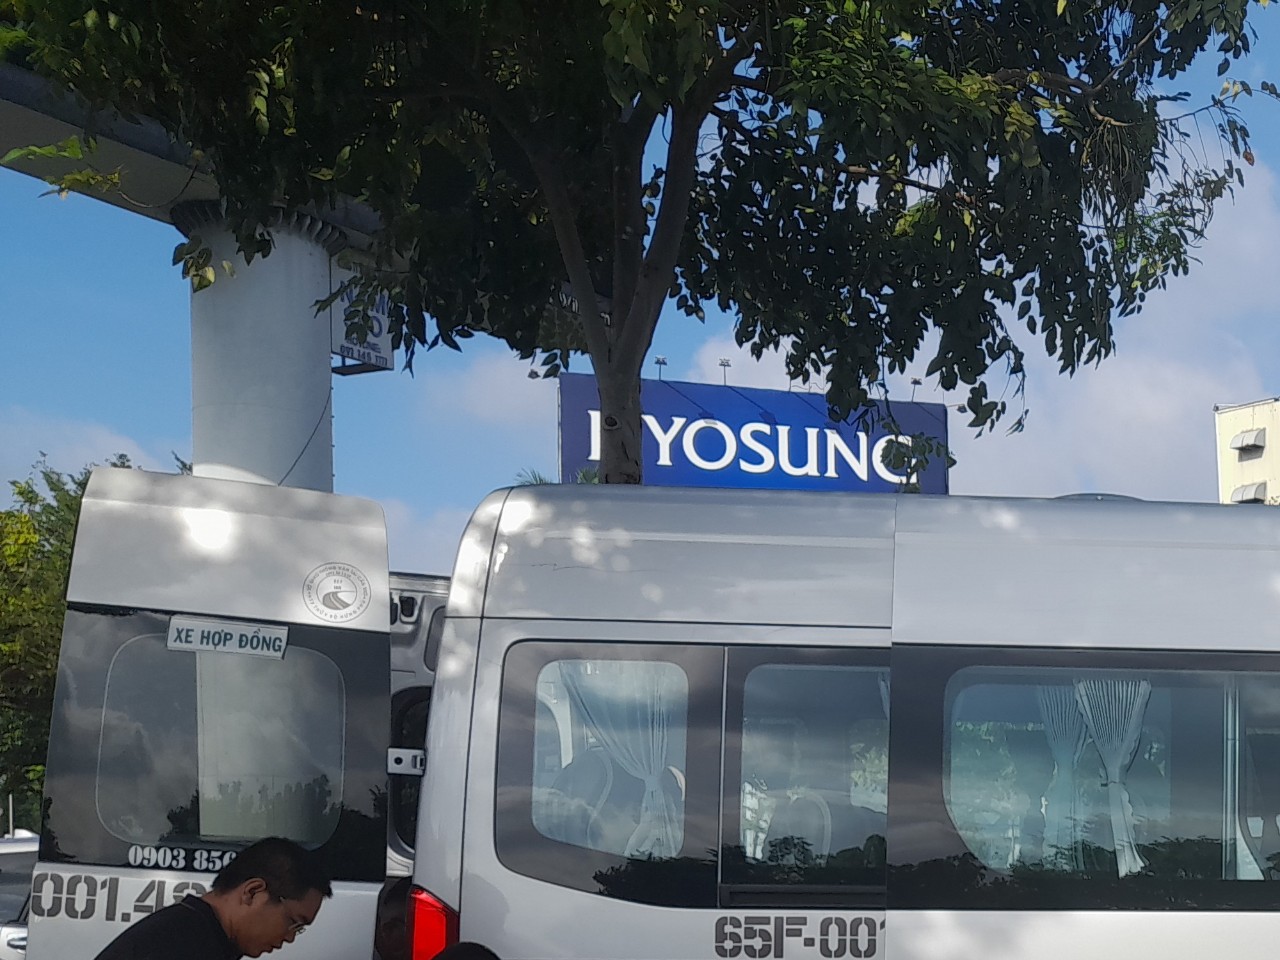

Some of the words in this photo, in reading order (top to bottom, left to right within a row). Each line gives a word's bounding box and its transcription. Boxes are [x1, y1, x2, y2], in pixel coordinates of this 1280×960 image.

[174, 627, 194, 644] XE
[200, 629, 233, 650] HỢP
[238, 628, 283, 652] ĐỒNG
[128, 844, 186, 870] 0903
[715, 916, 886, 959] 65F-00
